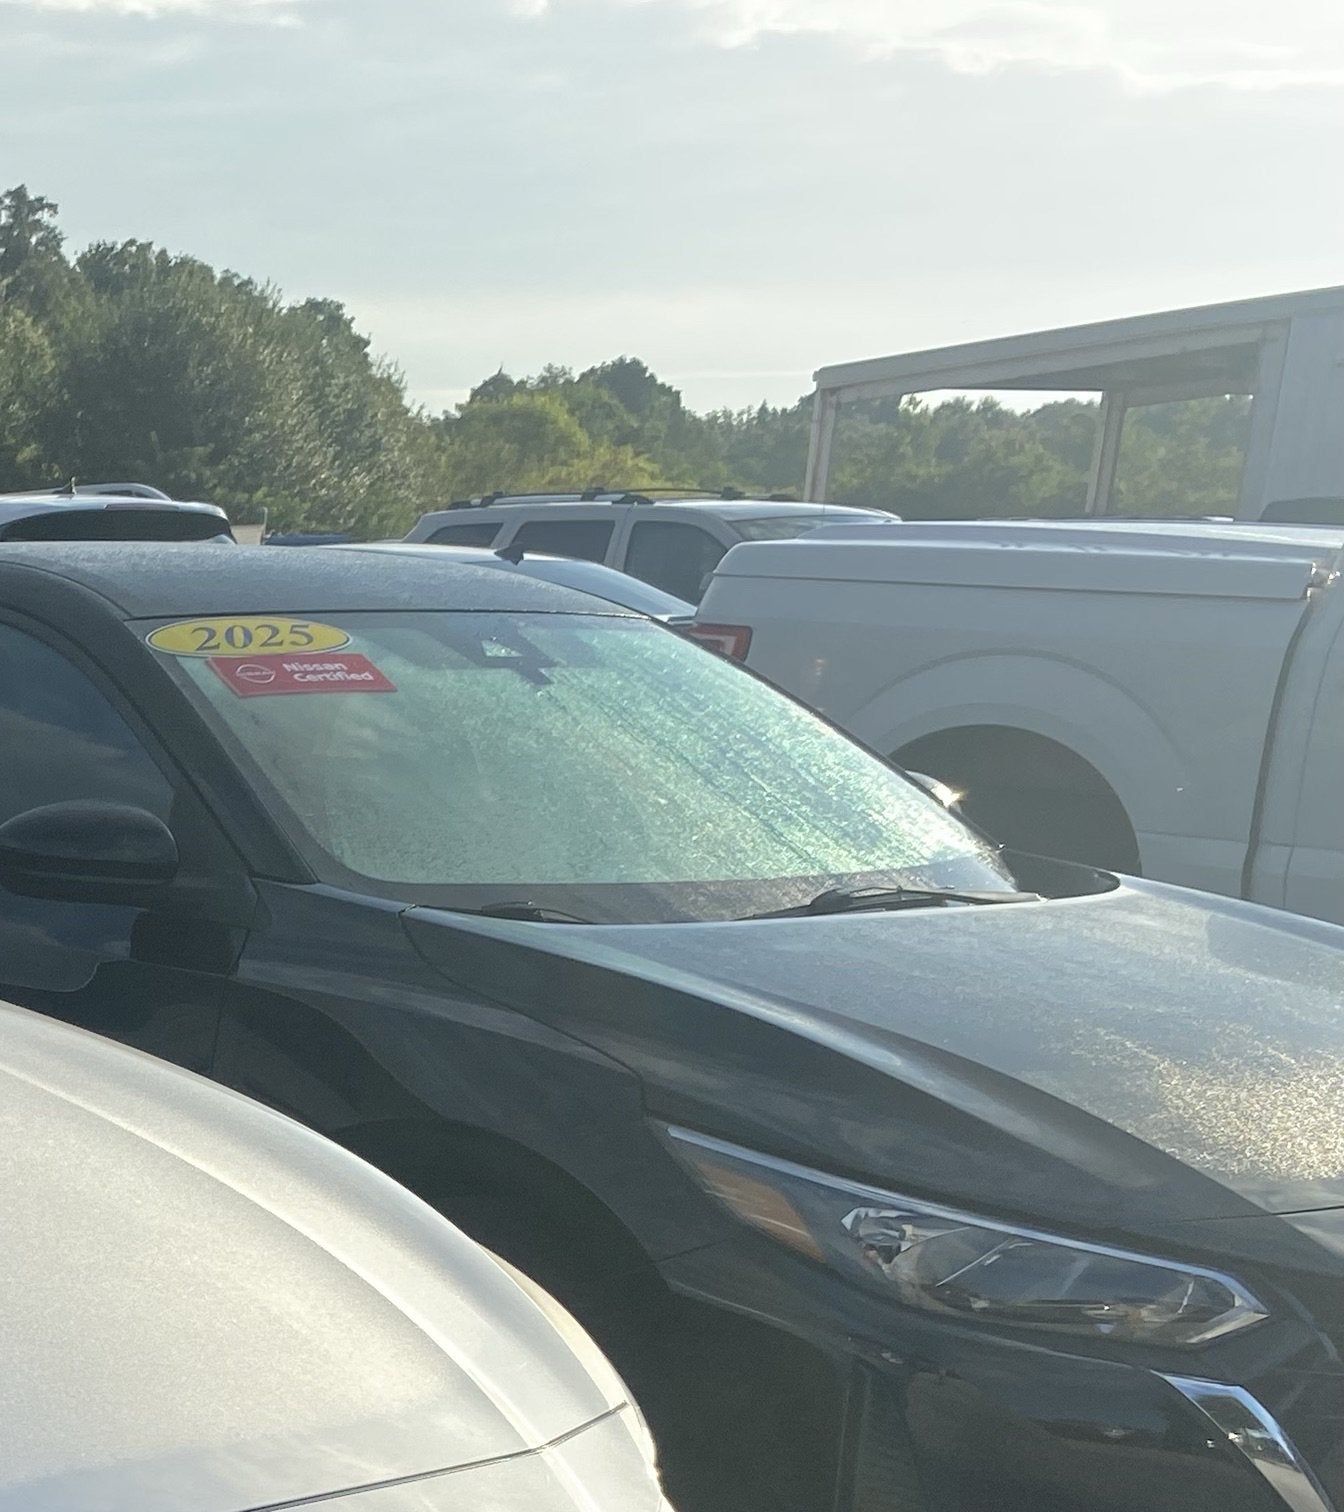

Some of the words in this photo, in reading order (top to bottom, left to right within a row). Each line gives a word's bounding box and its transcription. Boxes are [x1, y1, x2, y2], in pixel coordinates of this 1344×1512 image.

[191, 623, 314, 652] 2025
[283, 662, 347, 672] Nissan
[293, 670, 374, 682] Certified
